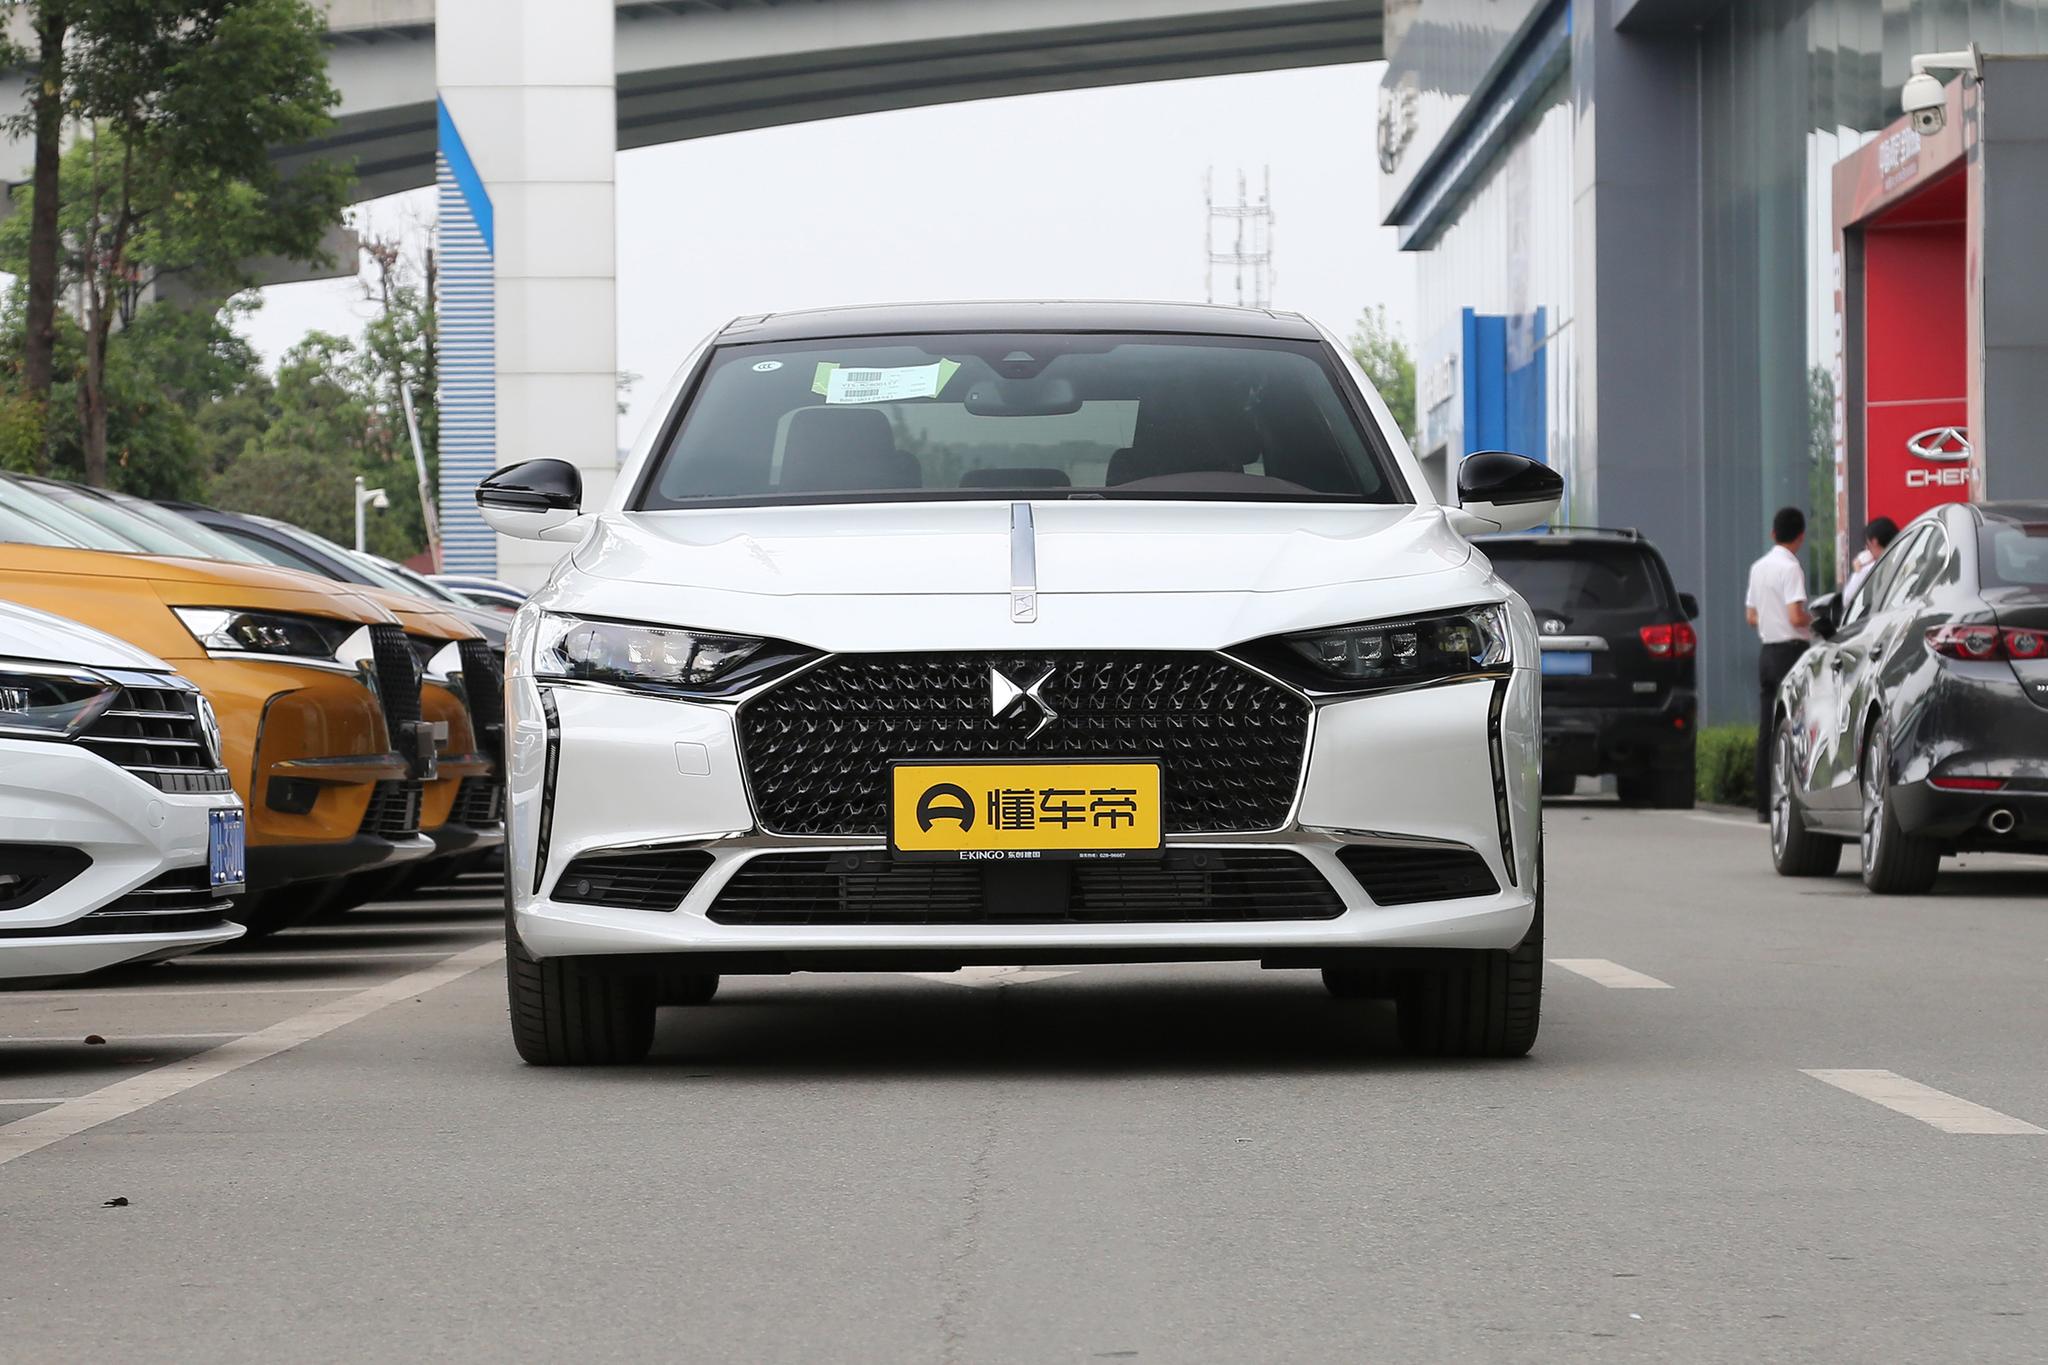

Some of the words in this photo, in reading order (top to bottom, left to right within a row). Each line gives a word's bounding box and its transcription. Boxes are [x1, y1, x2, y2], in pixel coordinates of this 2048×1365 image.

[1906, 468, 1970, 488] CHER
[987, 787, 1137, 830] 懂车帝
[959, 850, 1005, 860] E-KINGO
